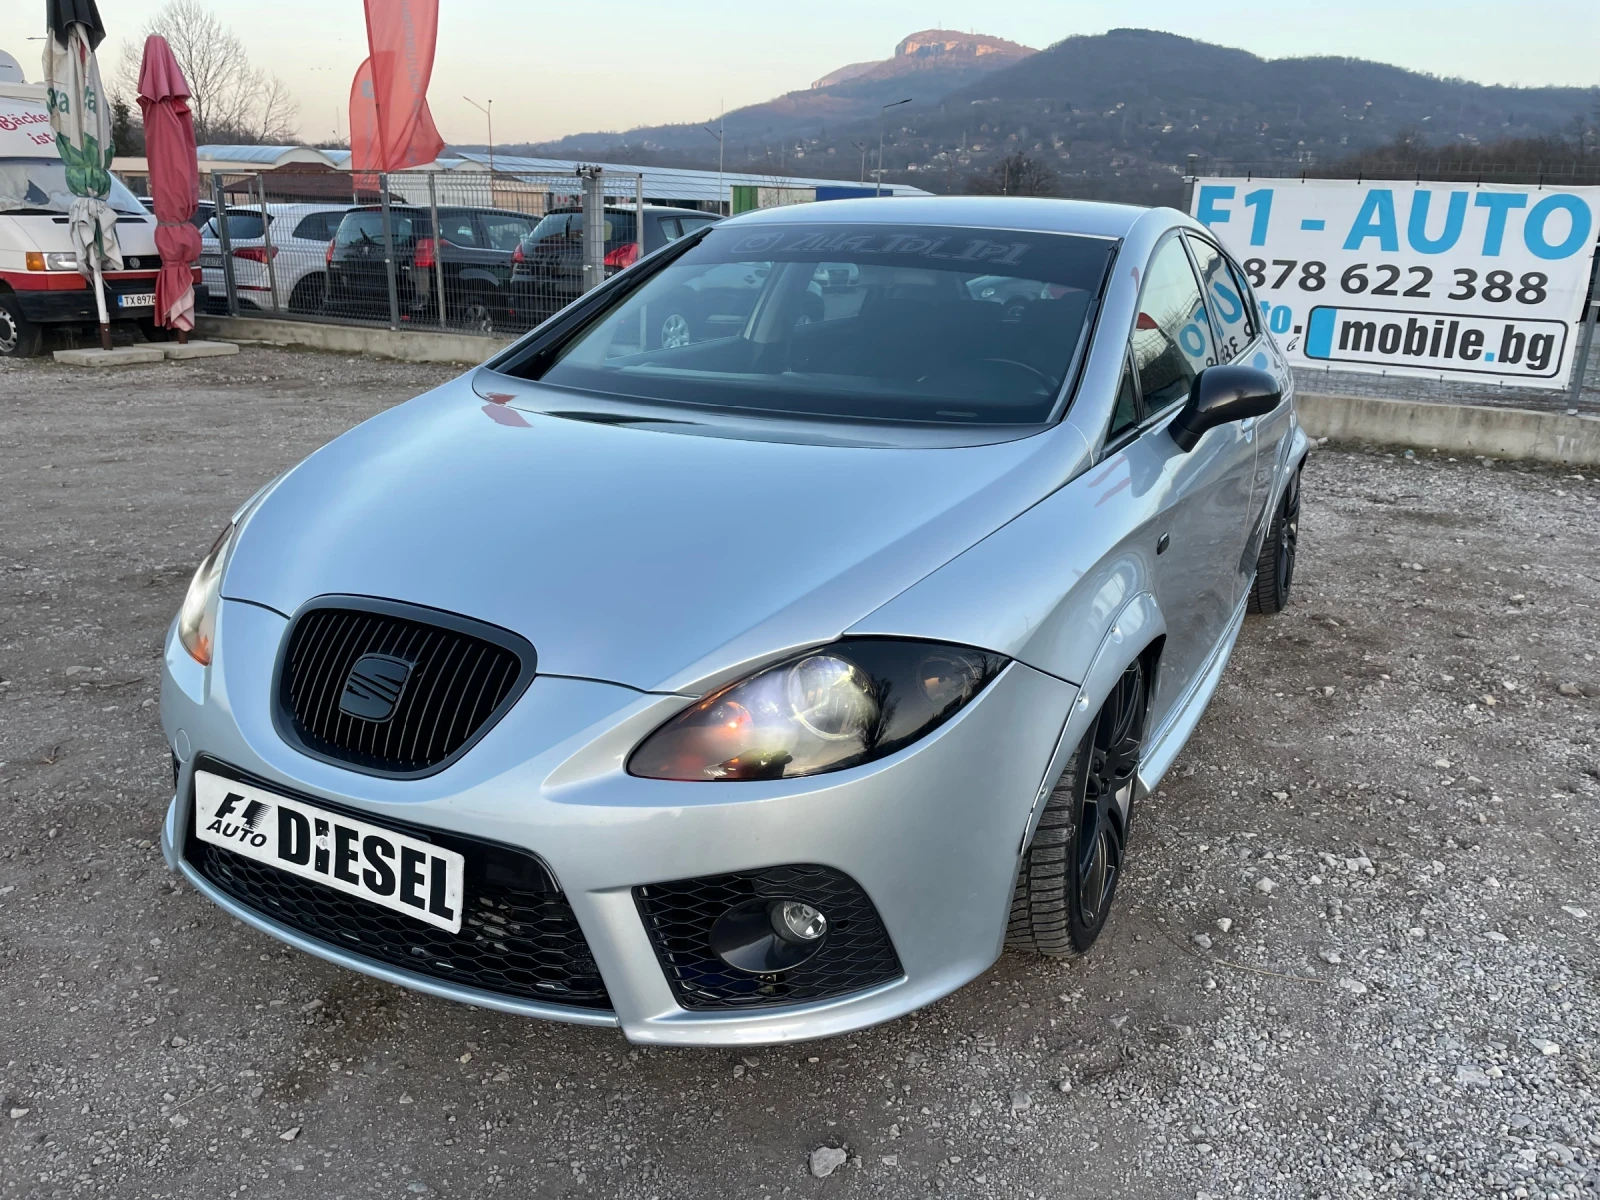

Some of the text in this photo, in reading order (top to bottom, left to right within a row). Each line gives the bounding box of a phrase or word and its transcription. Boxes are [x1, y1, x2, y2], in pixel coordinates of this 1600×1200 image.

[0, 112, 49, 131] Bäcke
[1197, 186, 1273, 246] F1
[1343, 189, 1591, 260] AUTO
[1340, 263, 1433, 298] 622
[1447, 268, 1548, 304] 388
[1338, 318, 1555, 370] mobile.bg
[214, 792, 272, 829] F1
[206, 819, 267, 848] AUTO
